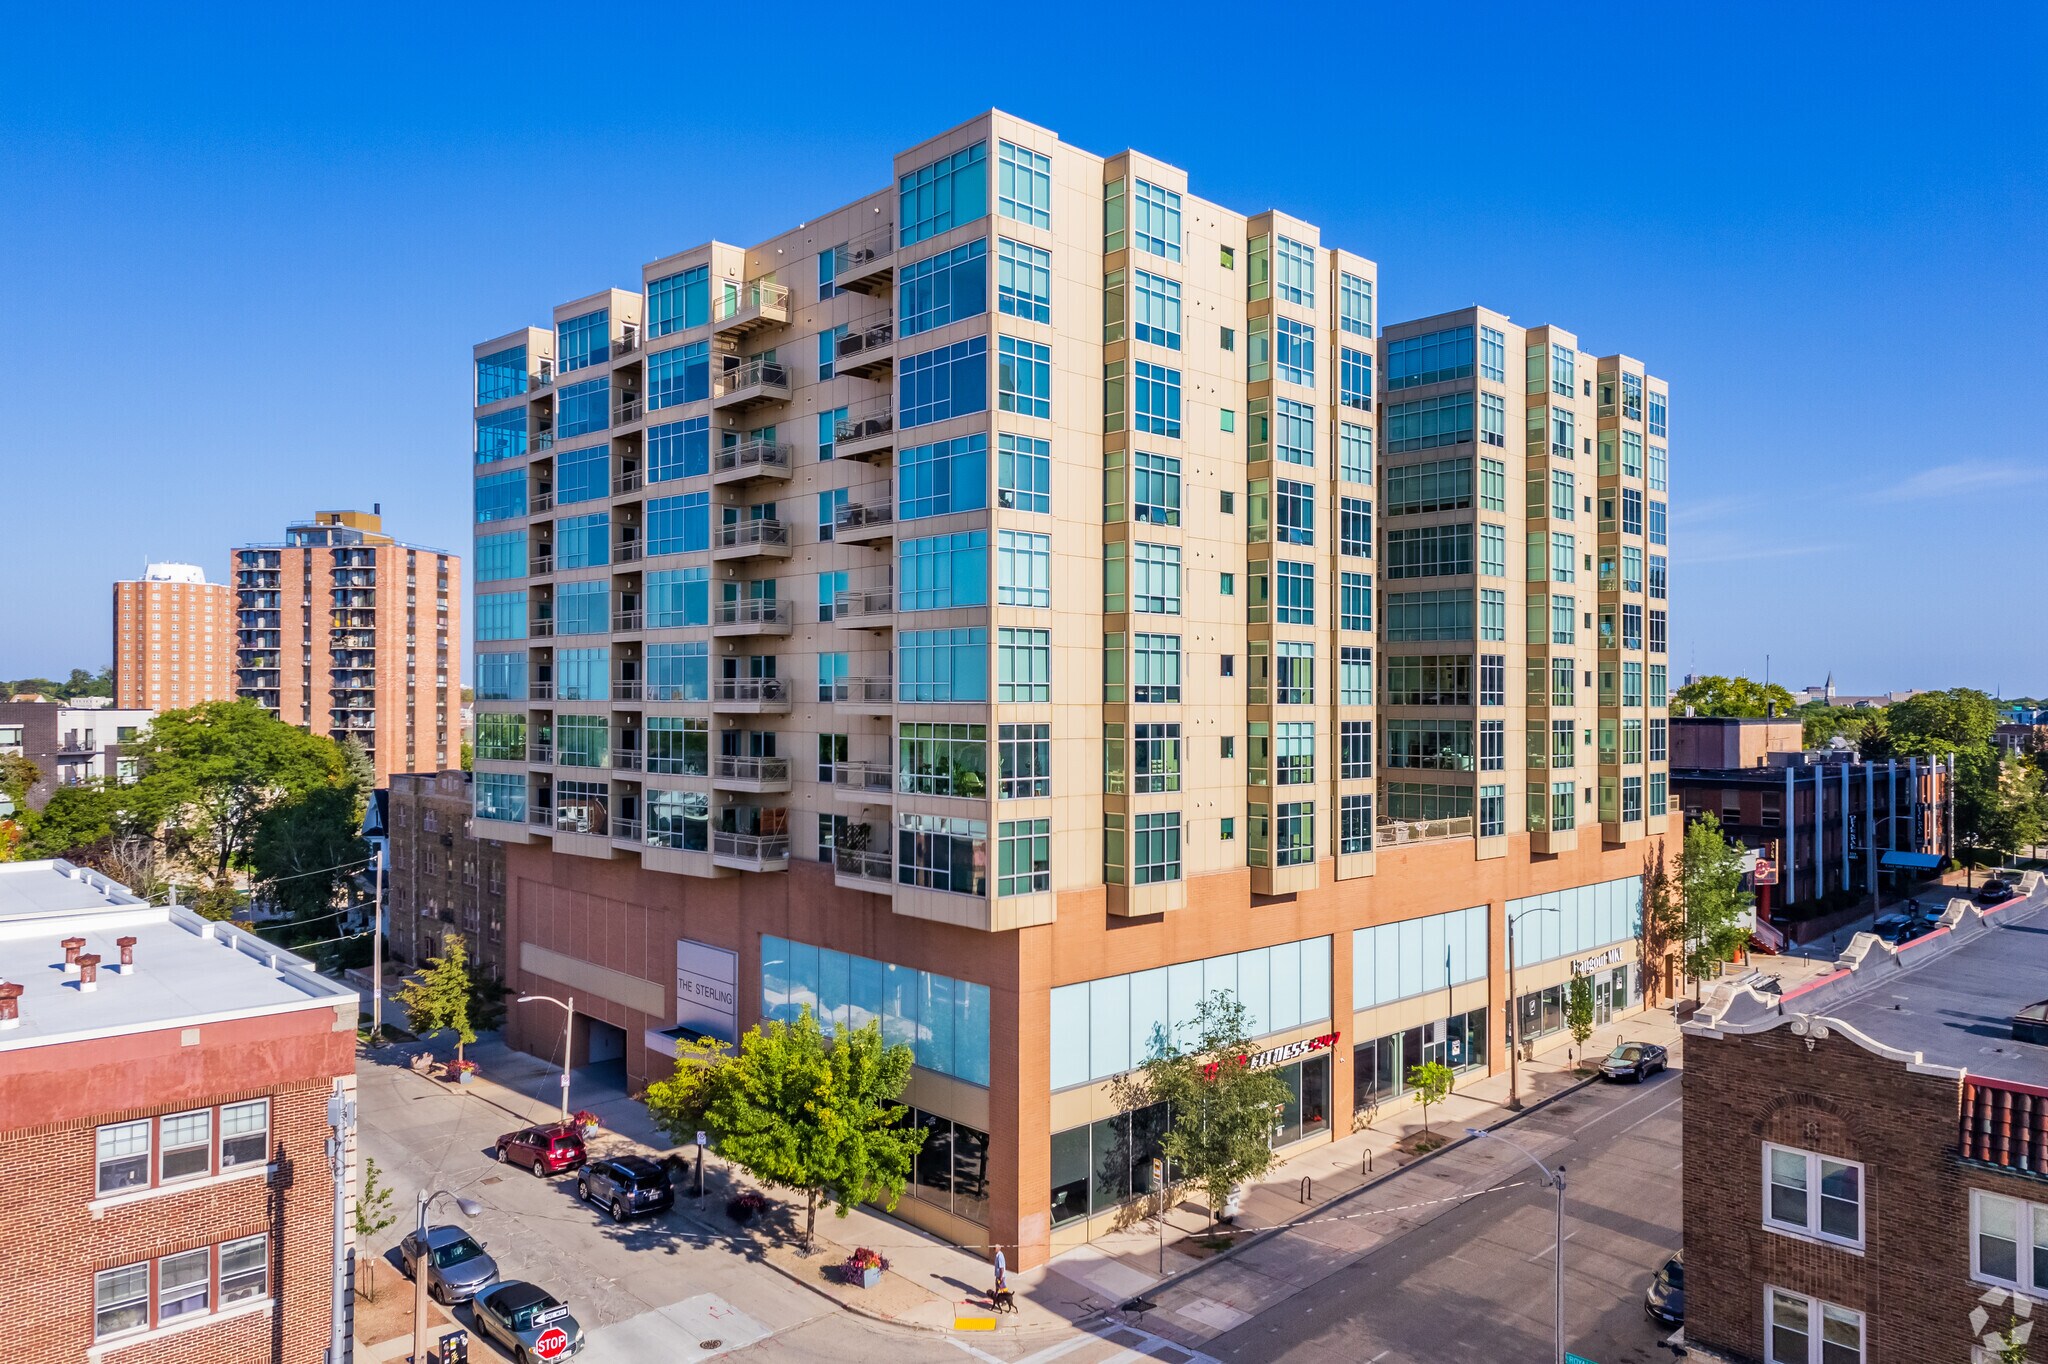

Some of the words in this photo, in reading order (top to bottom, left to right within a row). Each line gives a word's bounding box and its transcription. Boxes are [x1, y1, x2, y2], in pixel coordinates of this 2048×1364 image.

[1573, 953, 1608, 974] Hangout
[1608, 947, 1624, 964] MKE
[678, 977, 693, 993] THE
[695, 983, 733, 1005] STERLING
[1250, 1040, 1312, 1069] FITNESS
[538, 1335, 566, 1353] STOP
